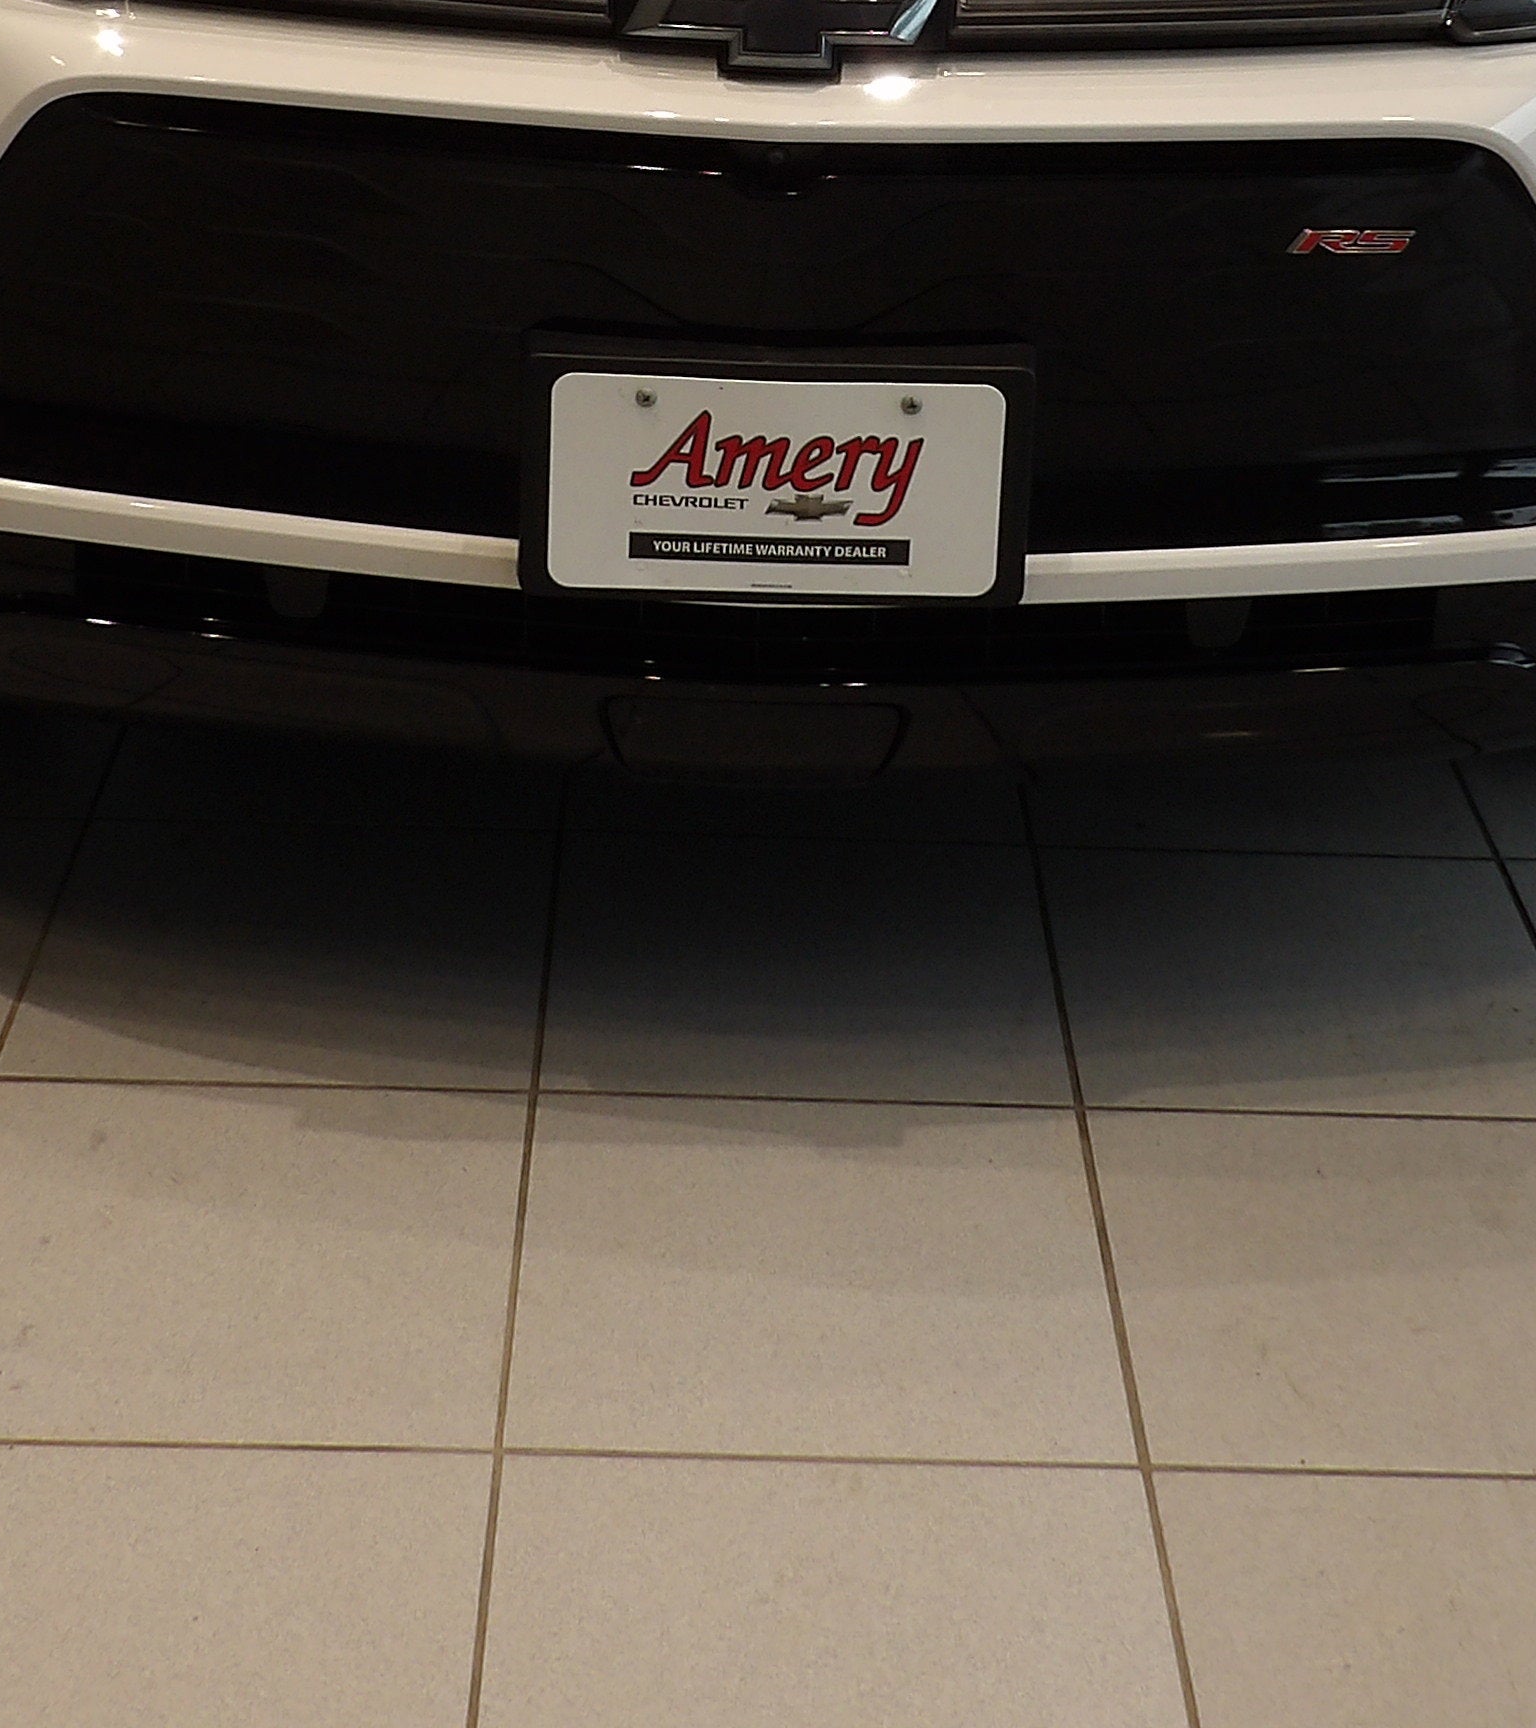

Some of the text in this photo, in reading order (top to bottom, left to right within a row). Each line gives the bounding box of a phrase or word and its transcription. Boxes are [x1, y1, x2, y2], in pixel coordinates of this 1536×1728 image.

[1286, 228, 1417, 254] RS
[629, 409, 925, 527] Amery
[632, 493, 750, 510] CHEVROLET
[652, 540, 887, 559] YOUR LIFETIME WARRANTY DEALER
